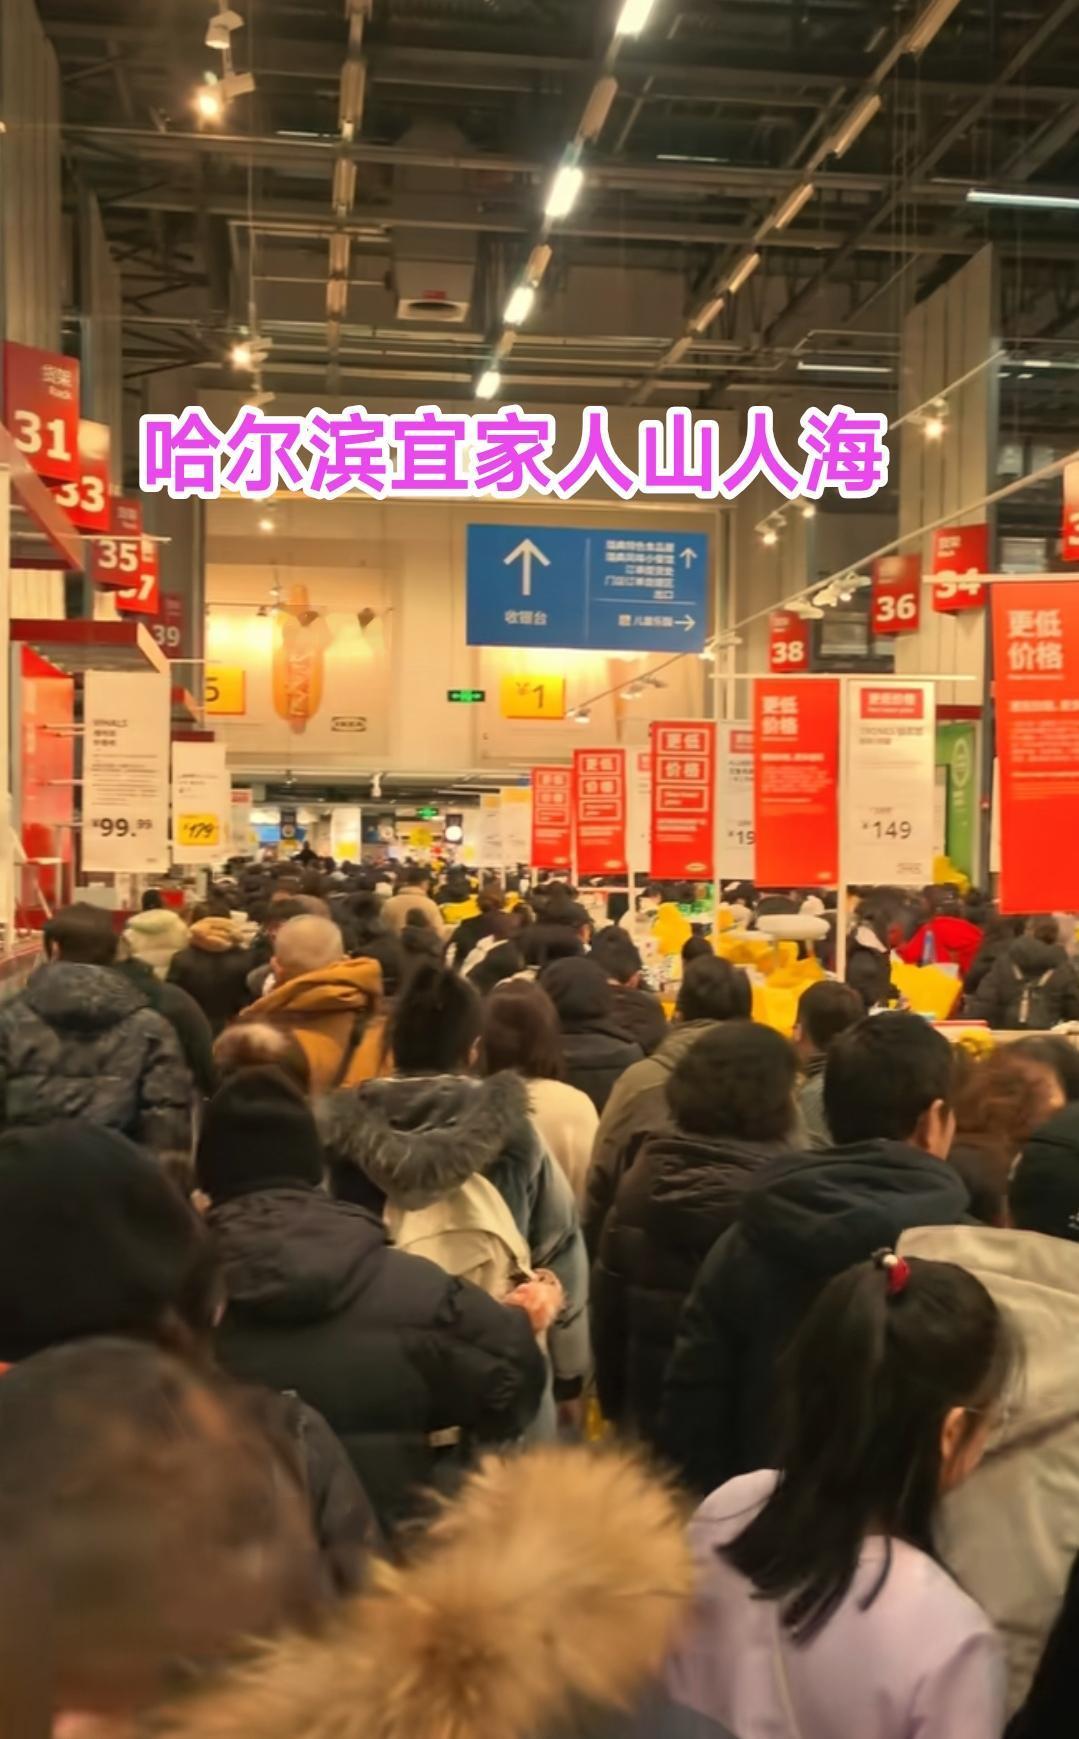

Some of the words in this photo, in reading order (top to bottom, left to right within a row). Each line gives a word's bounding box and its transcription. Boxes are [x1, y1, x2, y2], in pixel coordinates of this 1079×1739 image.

[14, 410, 71, 461] 31
[98, 540, 139, 571] 35
[876, 594, 916, 621] 36
[153, 624, 180, 647] 39
[1007, 609, 1062, 638] 更低
[771, 641, 804, 663] 38
[1007, 641, 1064, 670] 价格
